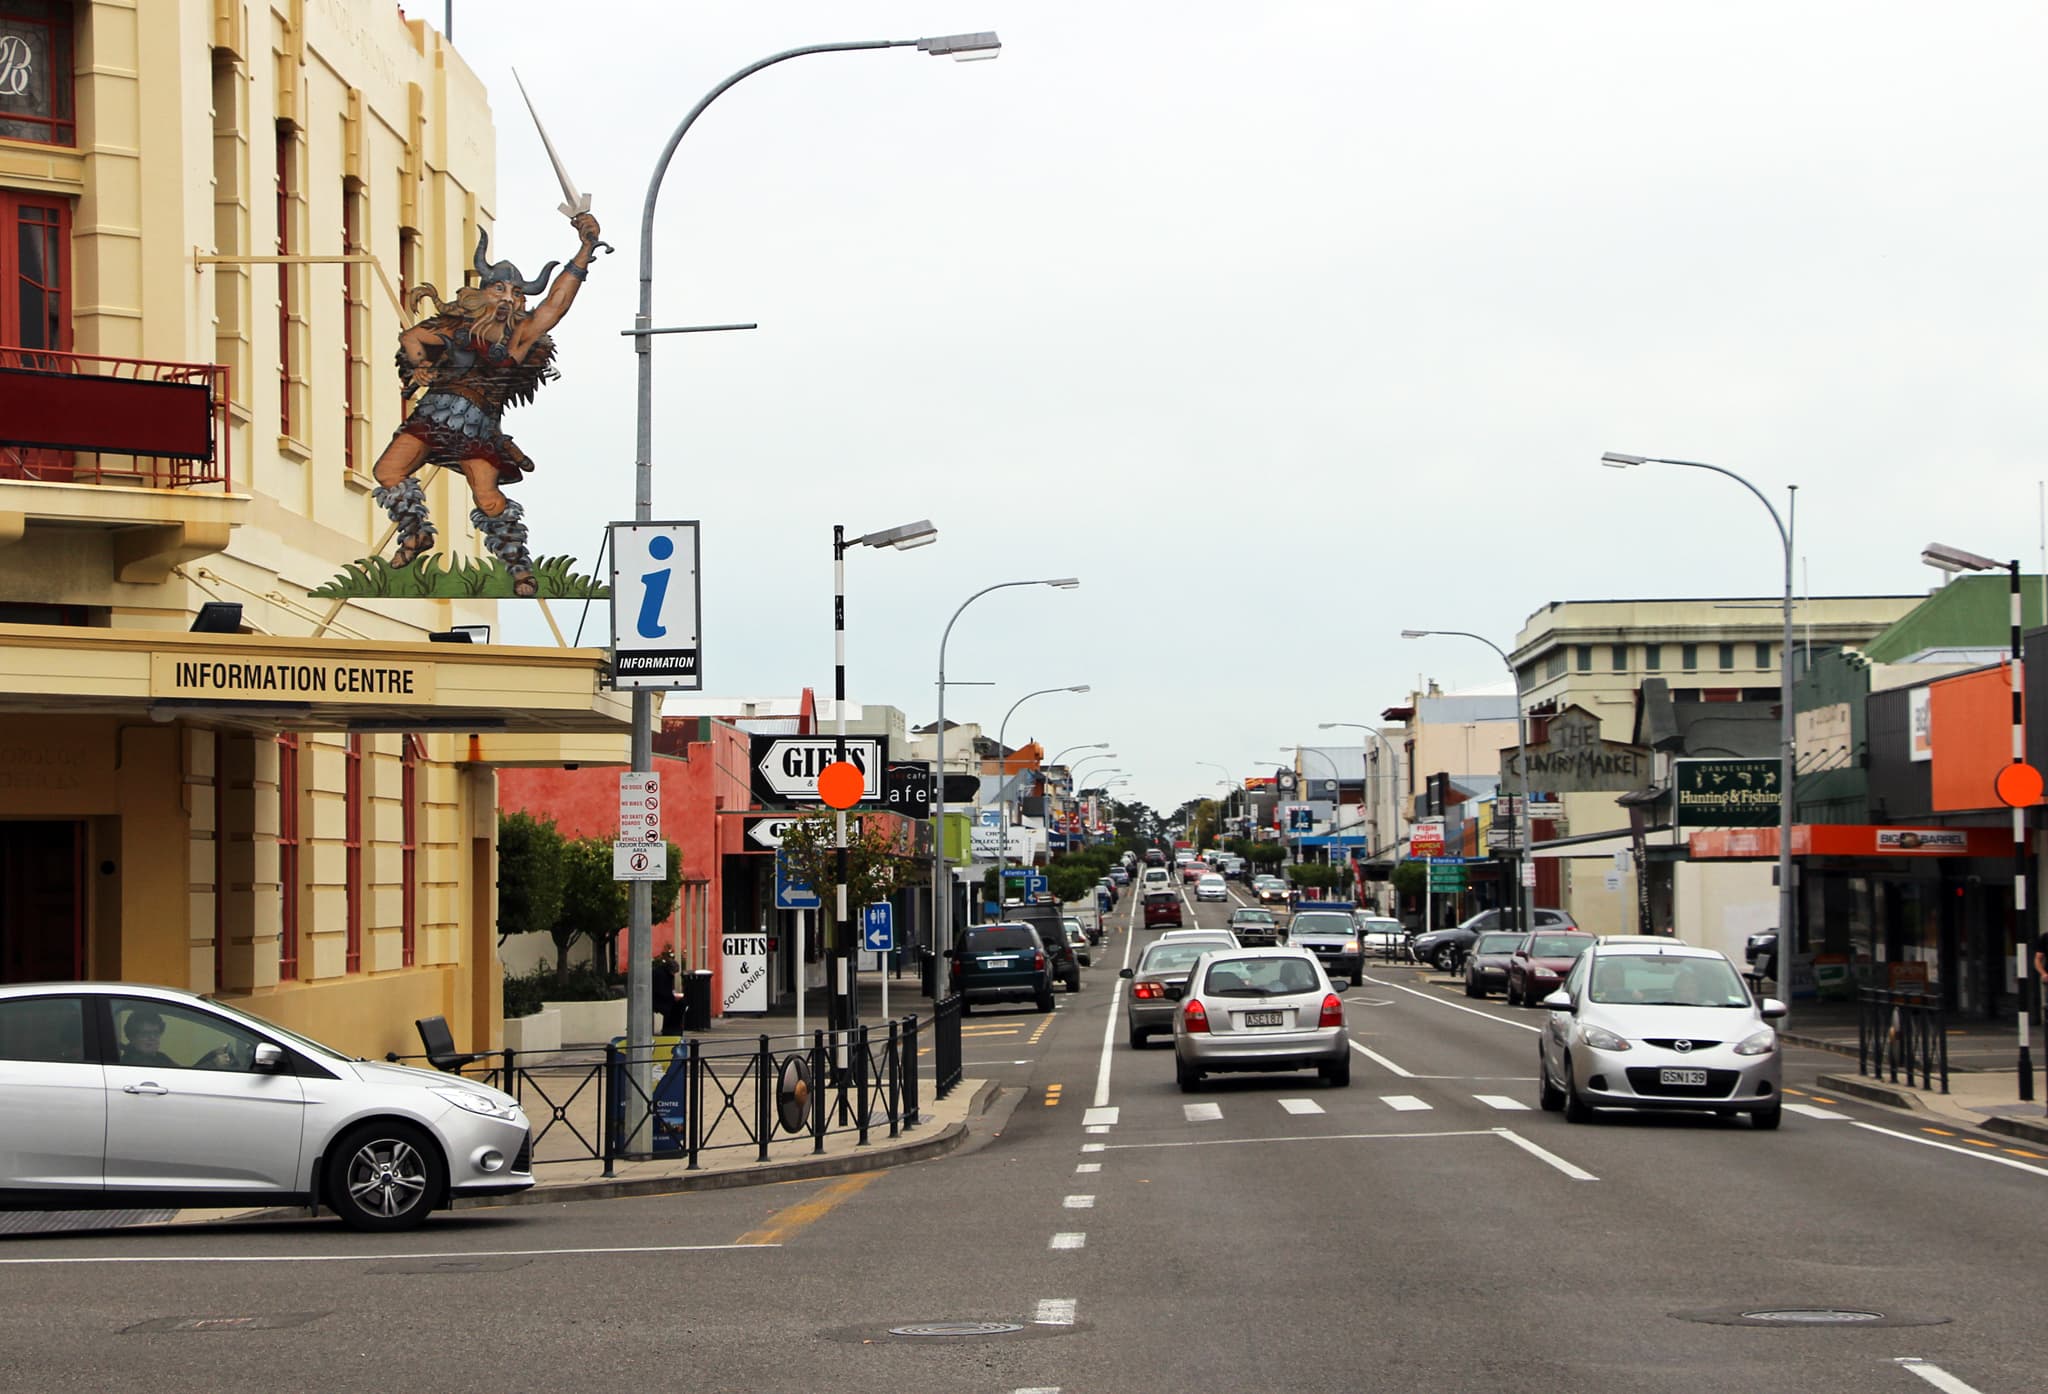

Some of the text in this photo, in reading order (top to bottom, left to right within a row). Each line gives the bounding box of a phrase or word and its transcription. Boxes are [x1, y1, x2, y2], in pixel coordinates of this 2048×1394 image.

[619, 656, 695, 669] INFORMATION
[176, 662, 414, 694] INFORMATION CENTRE
[1553, 723, 1596, 747] THE
[889, 784, 927, 803] afe
[1879, 833, 1965, 845] BIG BARREL
[1030, 878, 1042, 892] P
[722, 937, 766, 956] GIFTS
[740, 961, 750, 974] &
[723, 966, 766, 1009] SOUVENIRS
[1663, 1071, 1705, 1084] GSN139
